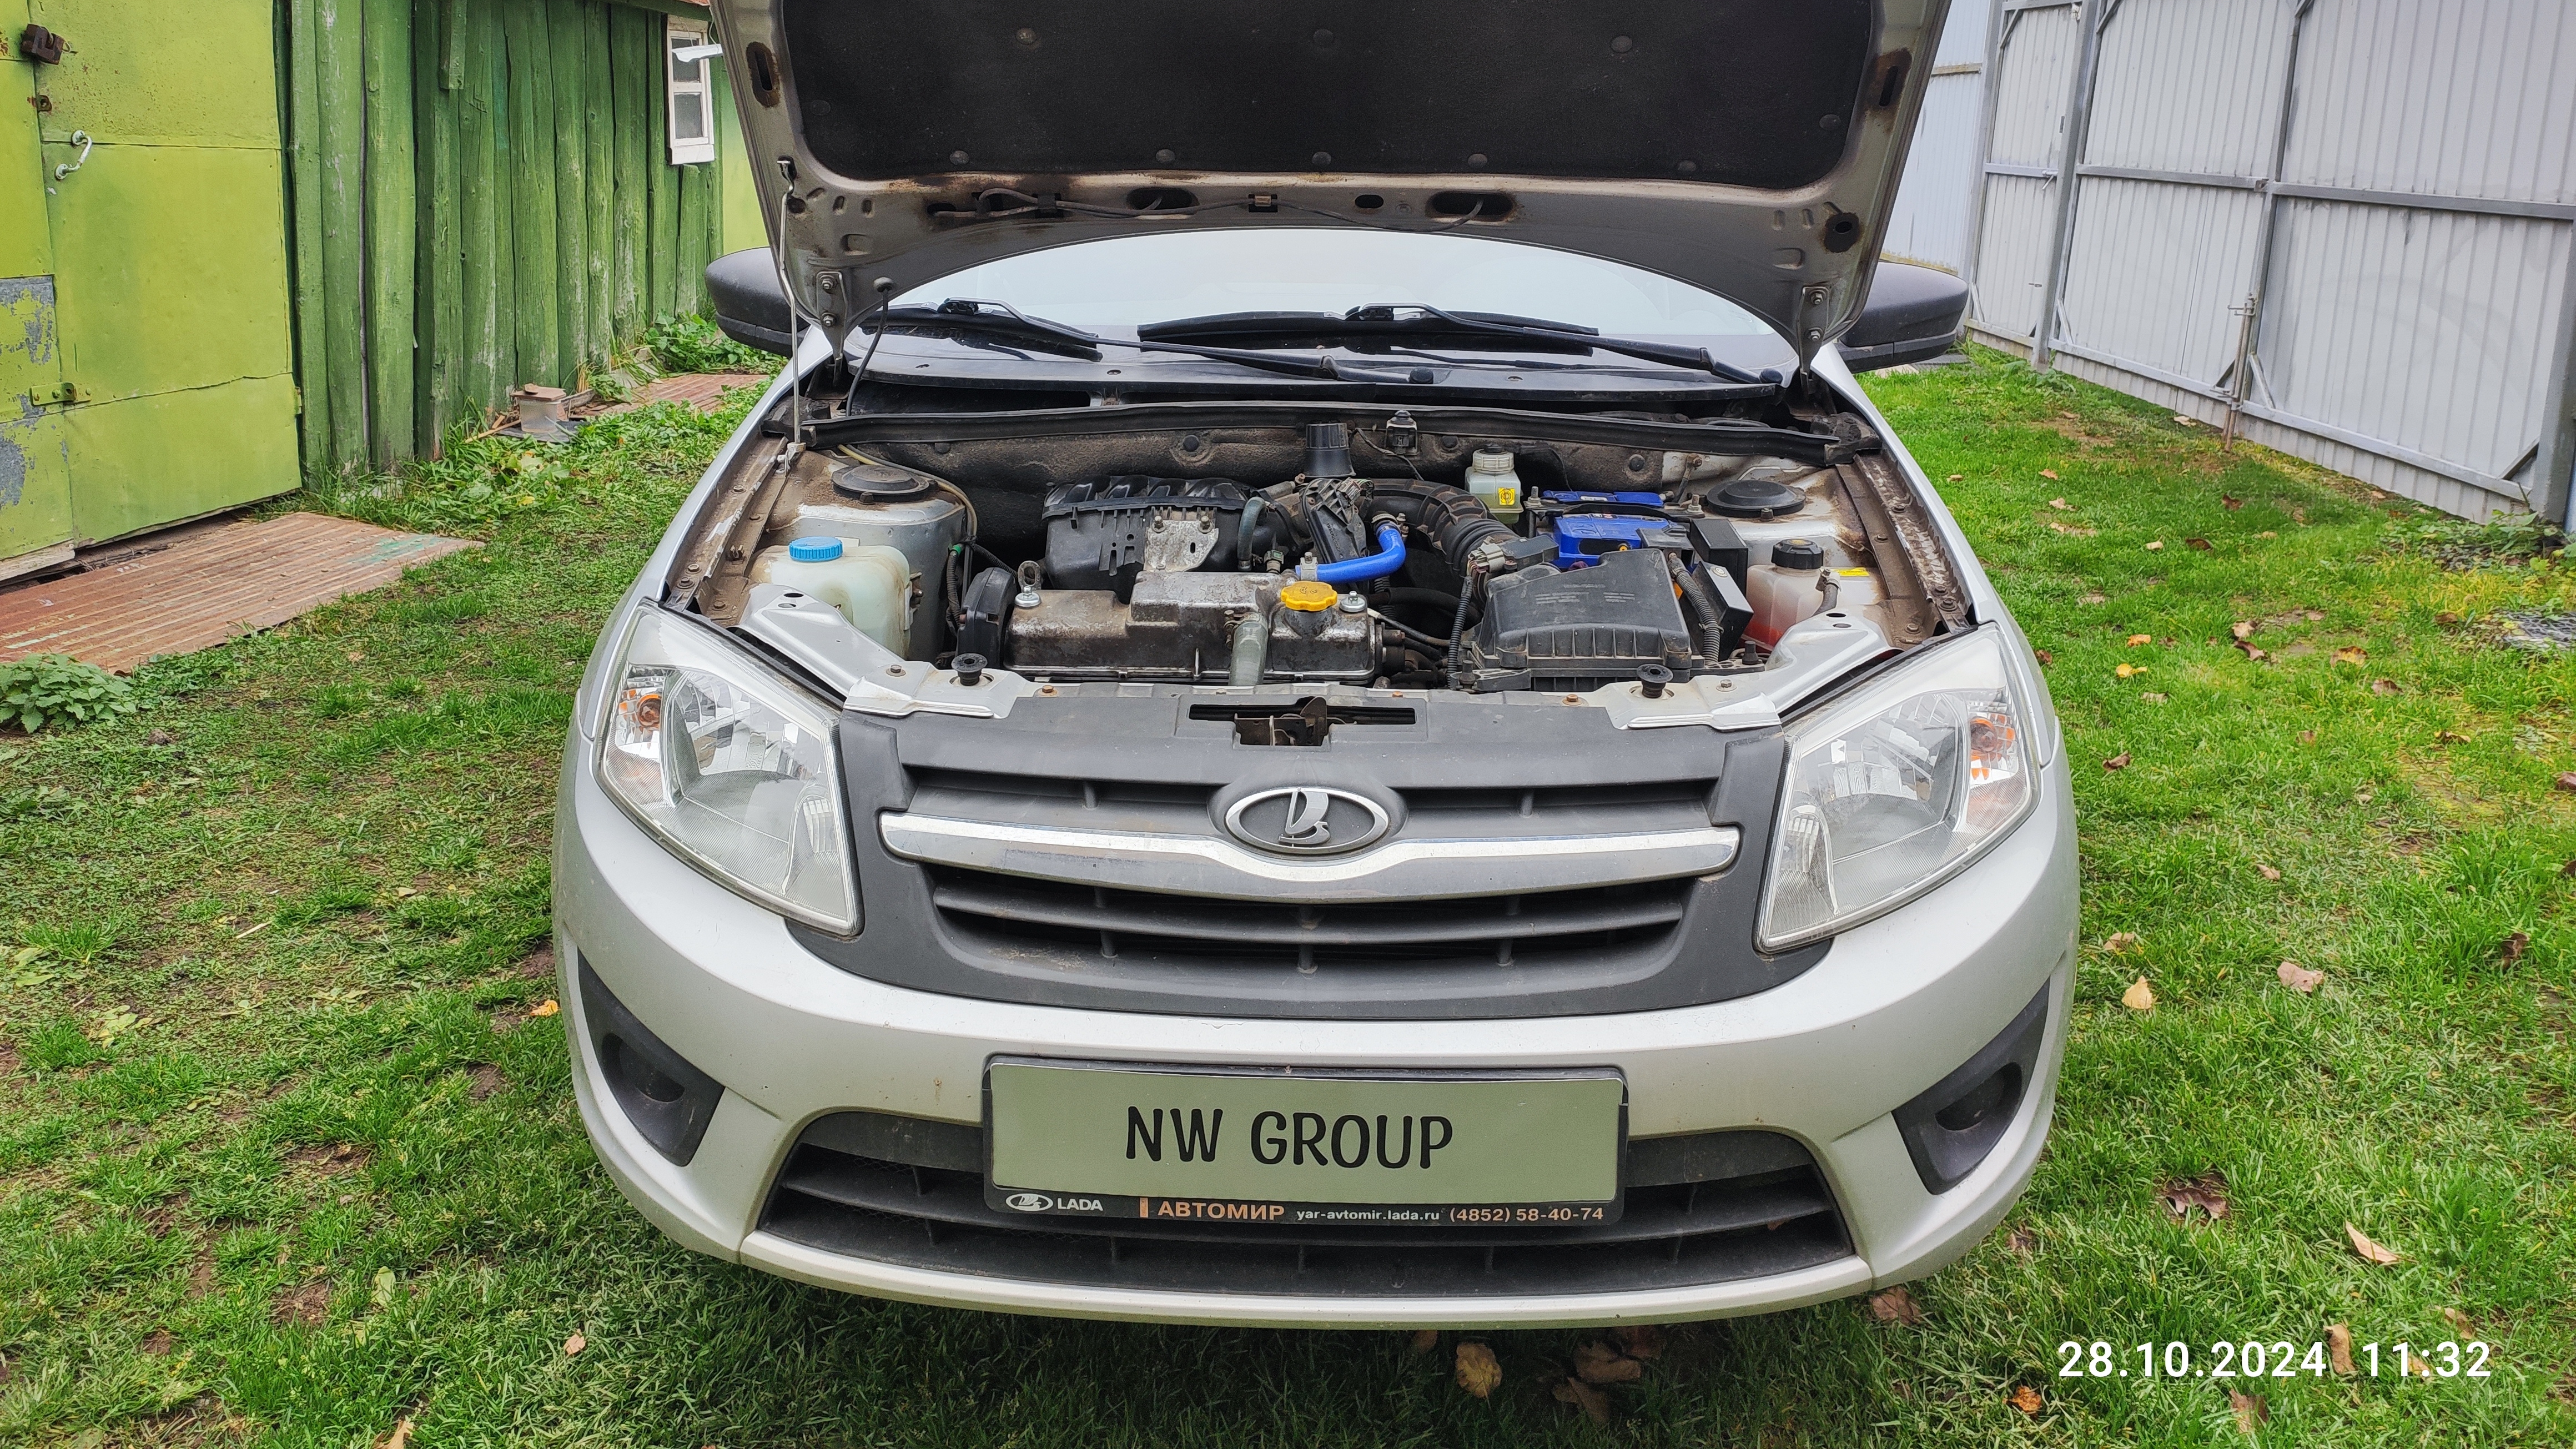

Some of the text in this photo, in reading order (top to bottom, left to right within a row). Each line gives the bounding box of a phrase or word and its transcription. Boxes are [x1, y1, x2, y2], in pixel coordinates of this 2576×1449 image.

[1126, 1106, 1453, 1169] NW GROUP
[1057, 1198, 1104, 1211] LADA
[1157, 1200, 1285, 1220] АВТОМИР
[1296, 1208, 1604, 1222] yar-avtomir.lada.ru (4852) 58-40-74
